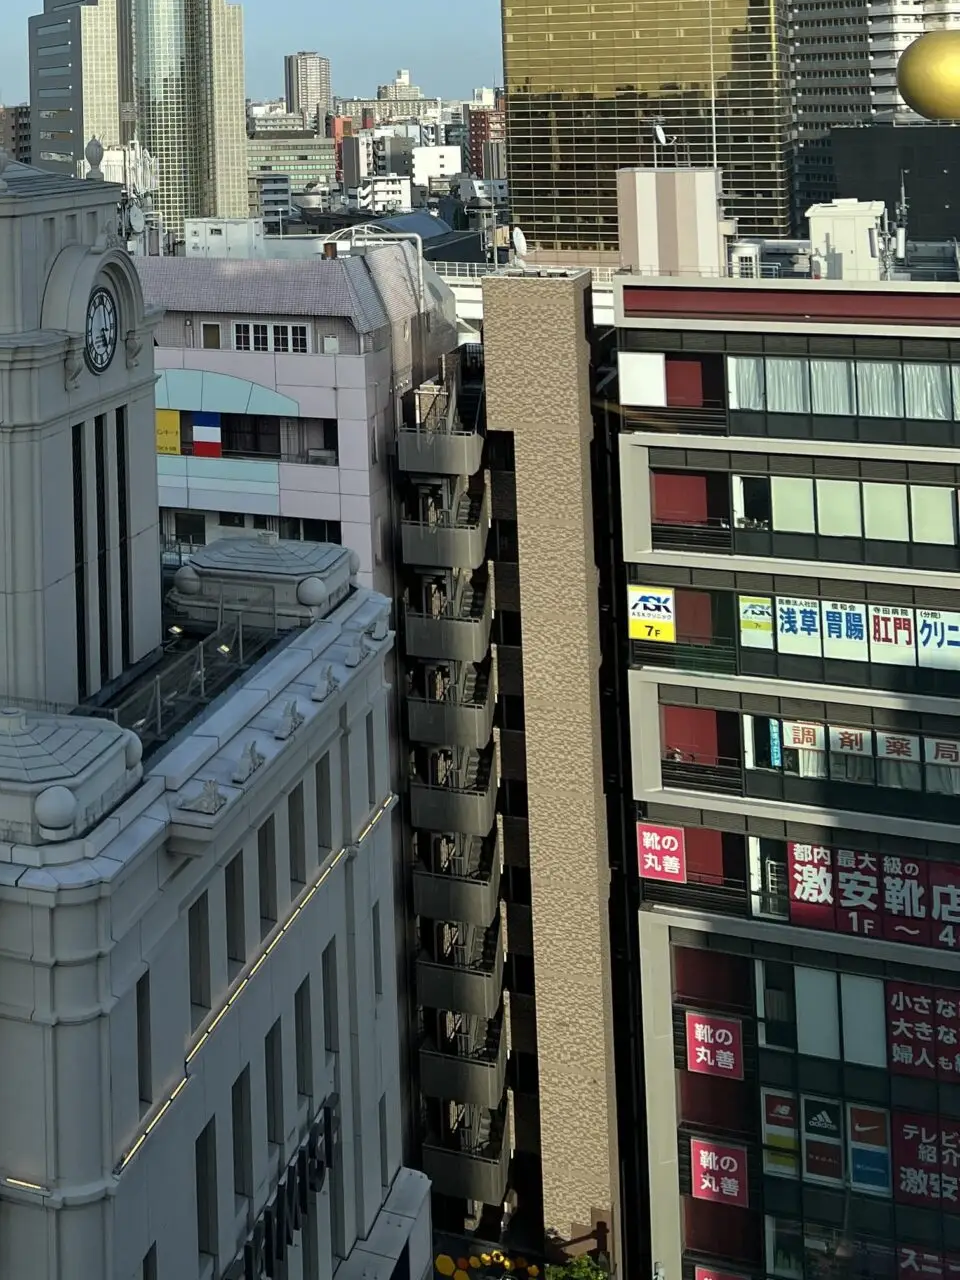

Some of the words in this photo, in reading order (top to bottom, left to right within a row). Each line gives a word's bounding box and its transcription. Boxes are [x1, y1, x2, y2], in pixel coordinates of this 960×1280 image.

[632, 596, 672, 613] ASK
[645, 625, 661, 637] 7F
[642, 831, 679, 852] 靴の
[643, 852, 681, 874] 丸善
[793, 843, 920, 876] 都内最大級の
[891, 991, 960, 1018] 小さな
[694, 1022, 733, 1046] 靴の
[891, 1018, 960, 1045] 大きな
[695, 1045, 735, 1070] 丸善
[892, 1043, 960, 1073] 婦人も
[902, 1124, 960, 1148] テレビ
[700, 1149, 738, 1173] 靴の
[700, 1173, 740, 1197] 丸善
[900, 1166, 960, 1202] 激安
